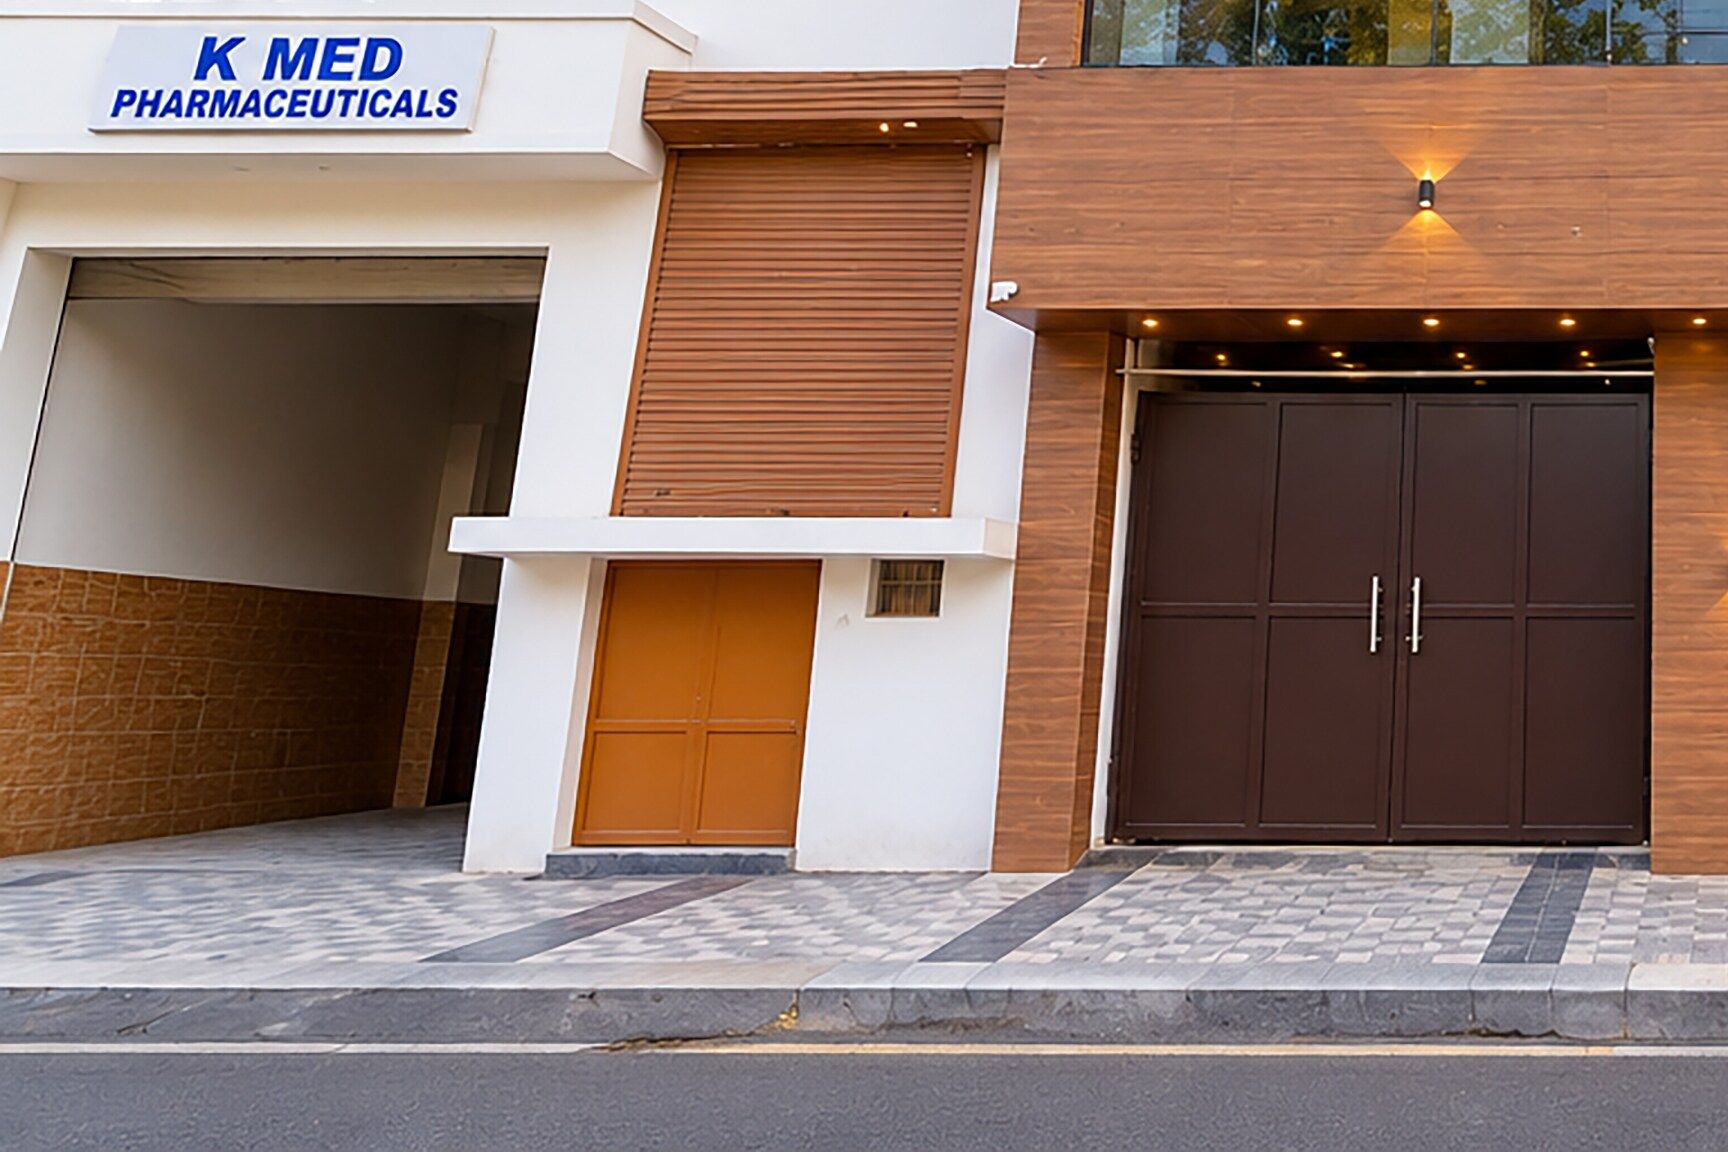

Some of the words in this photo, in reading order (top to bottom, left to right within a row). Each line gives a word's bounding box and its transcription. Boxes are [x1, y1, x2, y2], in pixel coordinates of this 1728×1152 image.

[193, 35, 246, 82] K
[262, 36, 404, 83] MED
[110, 87, 459, 119] PHARMACEUTICALS
